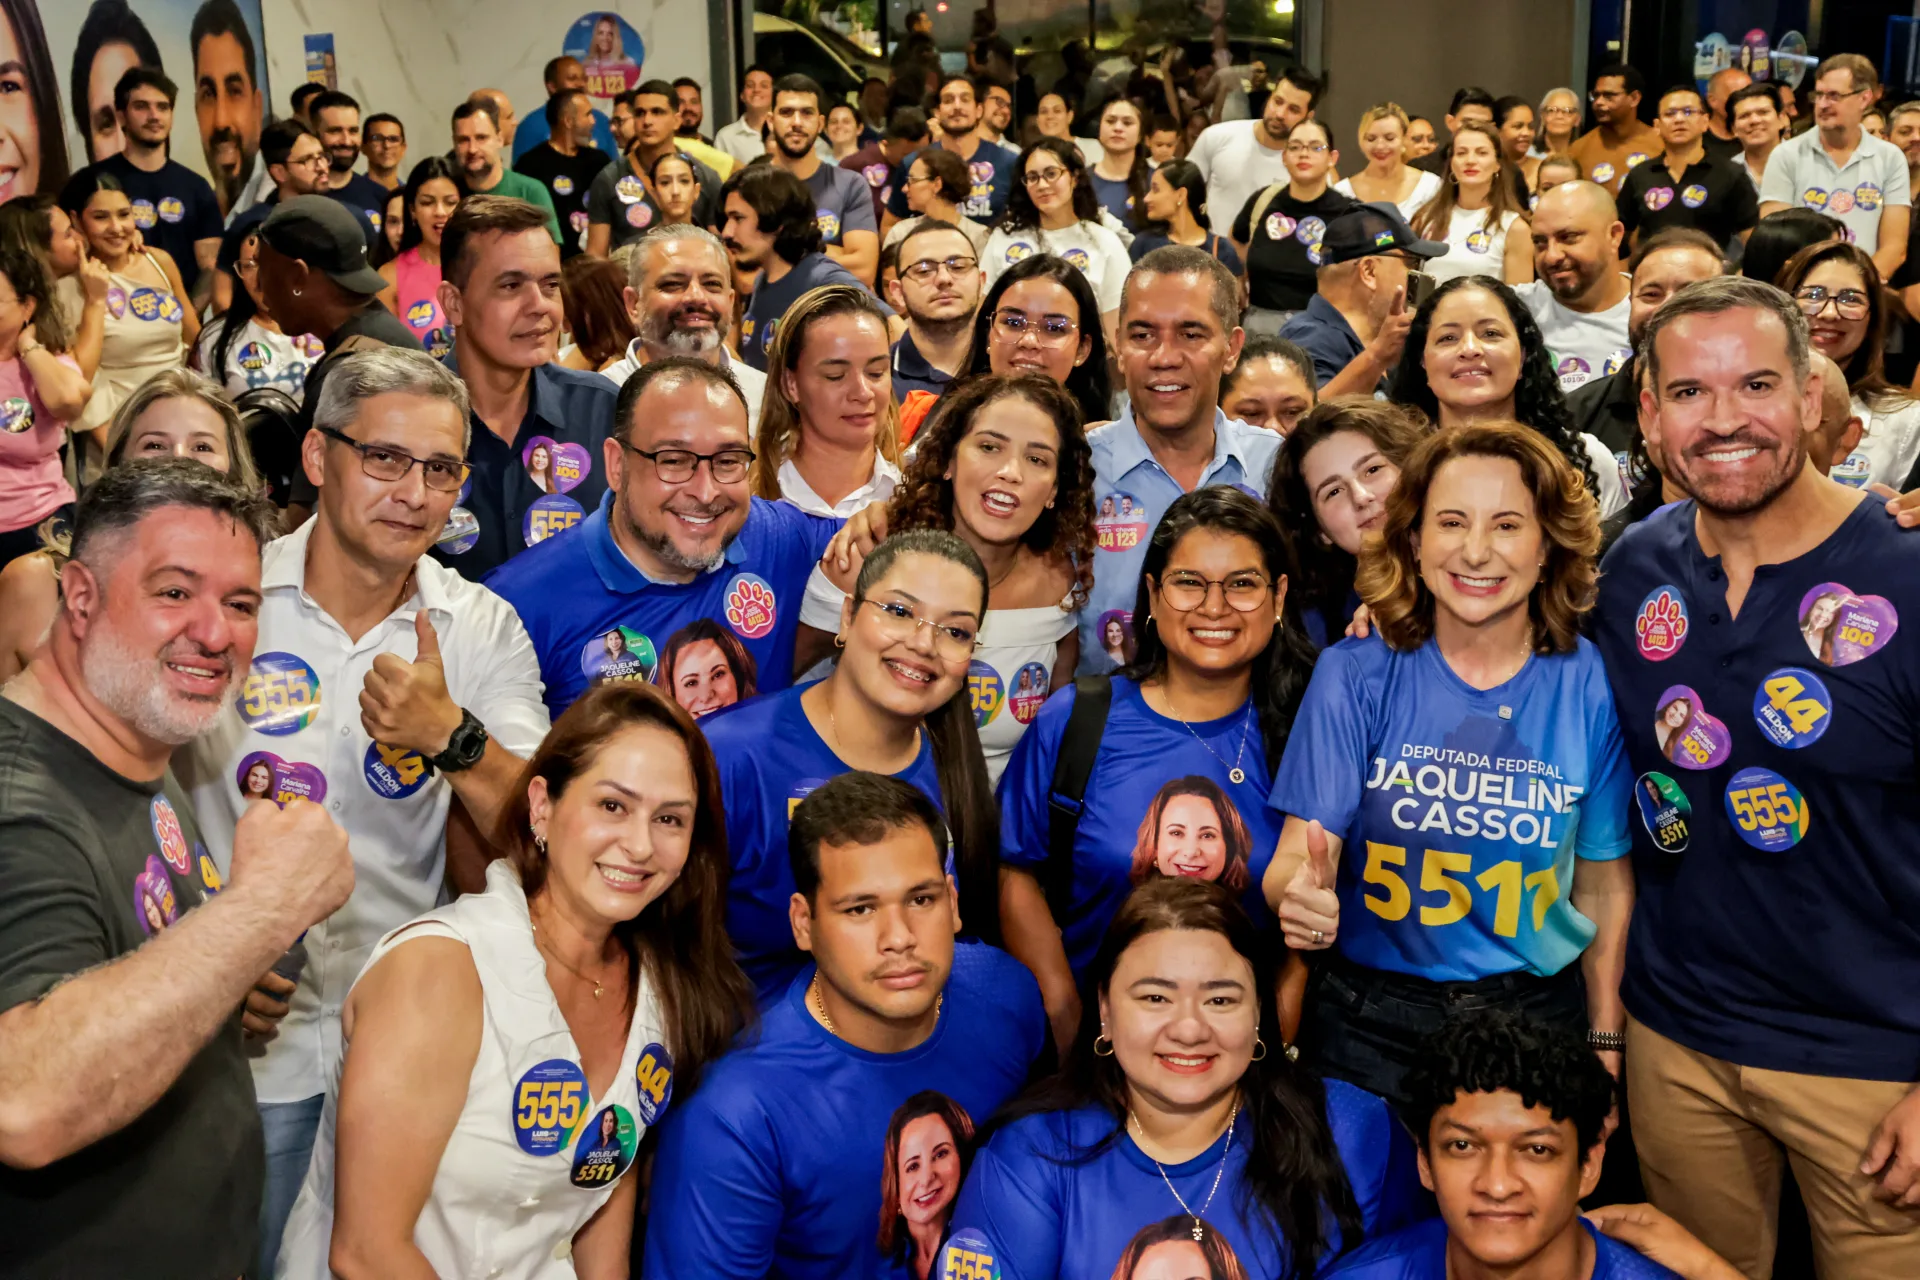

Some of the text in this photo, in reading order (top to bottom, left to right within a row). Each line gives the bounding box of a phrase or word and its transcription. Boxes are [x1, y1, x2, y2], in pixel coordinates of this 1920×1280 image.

[605, 75, 625, 93] 123
[556, 465, 581, 480] 100
[1099, 532, 1138, 547] 44 123
[1848, 611, 1880, 628] Mariana
[1838, 626, 1875, 647] 100
[601, 660, 642, 675] JAQUELINE
[605, 667, 638, 678] CASSOL
[243, 668, 314, 718] 555
[967, 676, 998, 711] 55
[1764, 675, 1829, 735] 44
[1760, 705, 1795, 741] HILDON
[1681, 734, 1709, 764] 100
[1694, 726, 1717, 751] Mariana
[1401, 743, 1564, 781] DEPUTADA FEDERAL
[280, 784, 310, 796] Carvalho
[281, 777, 311, 791] Mariana
[371, 761, 402, 793] HILDON
[1729, 783, 1799, 831] 555
[1390, 797, 1559, 849] CASSOL
[1660, 819, 1689, 846] 5511
[1363, 840, 1560, 939] 5511
[637, 1053, 671, 1105] 44
[517, 1081, 582, 1130] 555
[575, 1163, 617, 1182] 5511
[588, 1157, 613, 1165] CASSOL
